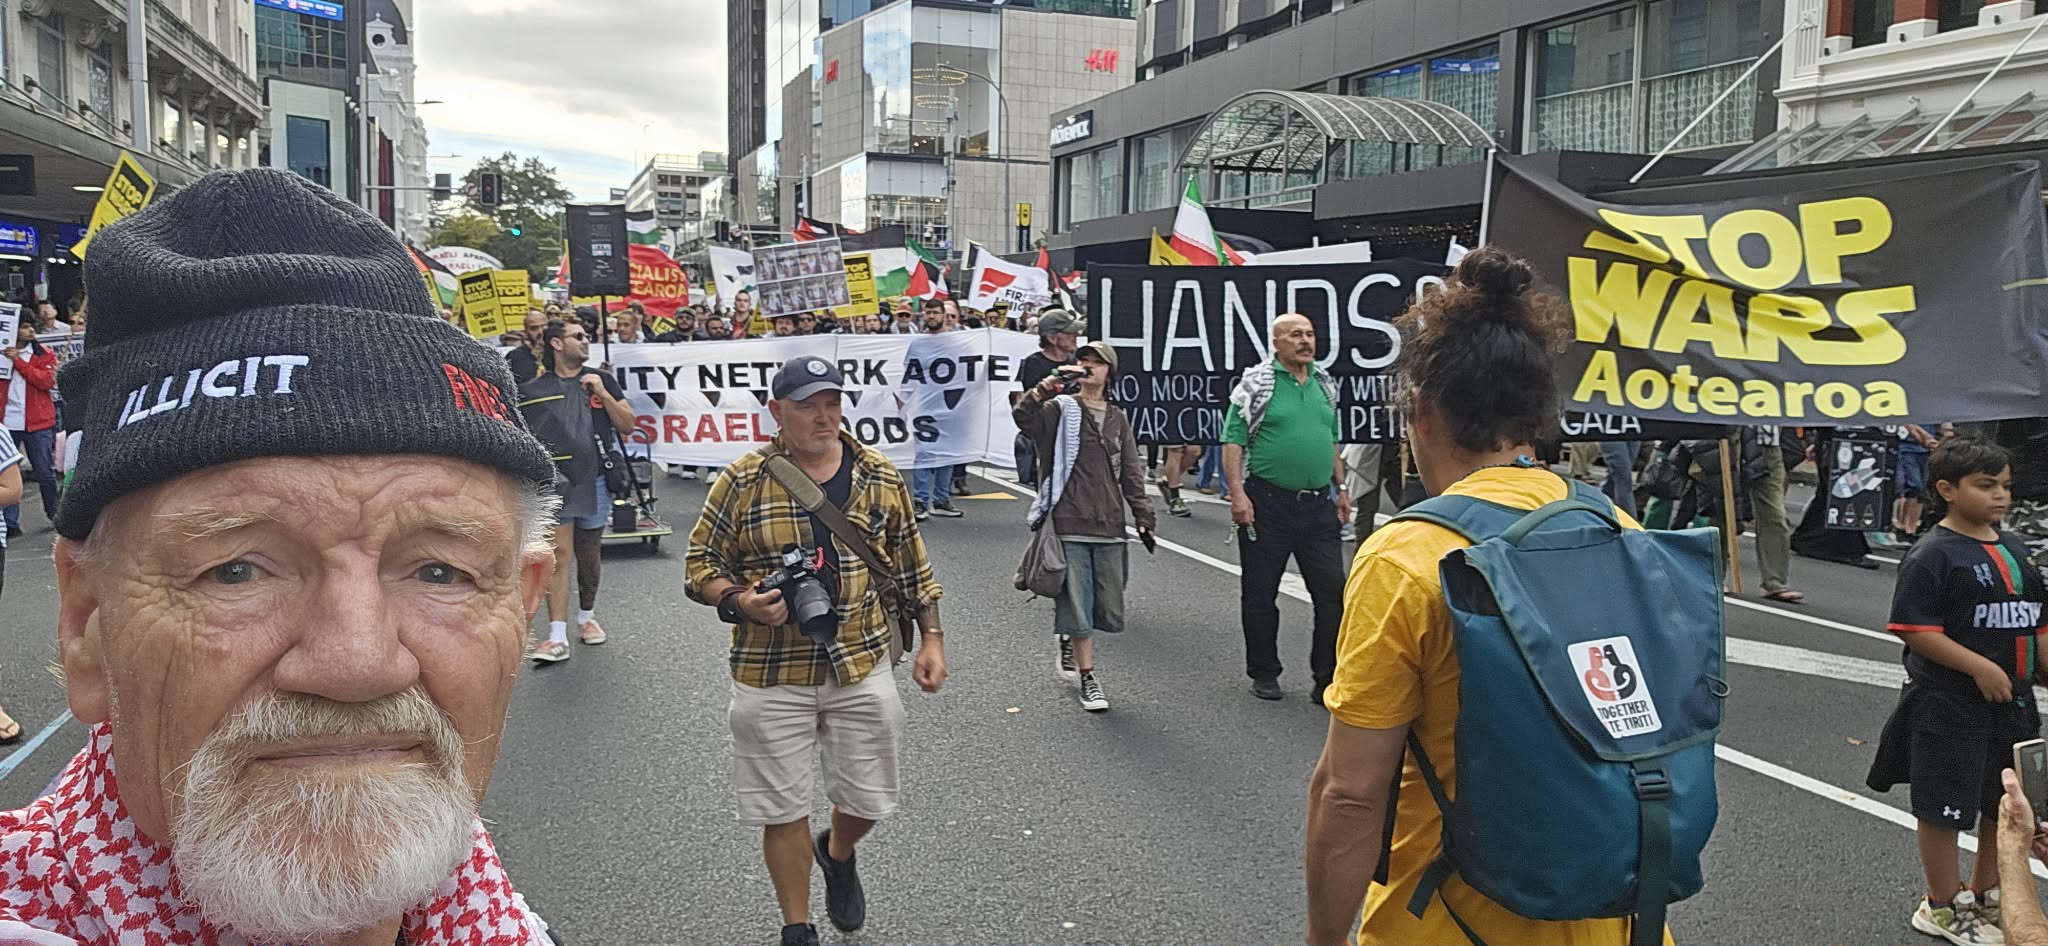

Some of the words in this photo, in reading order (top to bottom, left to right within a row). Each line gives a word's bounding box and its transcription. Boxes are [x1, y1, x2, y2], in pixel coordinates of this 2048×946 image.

[1583, 196, 1893, 290] STOP
[845, 263, 867, 272] TOP
[464, 280, 490, 294] STOP
[497, 286, 525, 296] TOP
[502, 306, 528, 315] ARS
[1101, 273, 1402, 372] HANDS
[1568, 256, 1916, 366] WARS
[617, 366, 683, 390] ITY
[1152, 375, 1221, 402] MORE
[1572, 350, 1909, 418] Aotearoa
[116, 354, 309, 432] ILLICIT
[622, 413, 777, 444] SRAEL
[1597, 700, 1649, 719] TOGETHER
